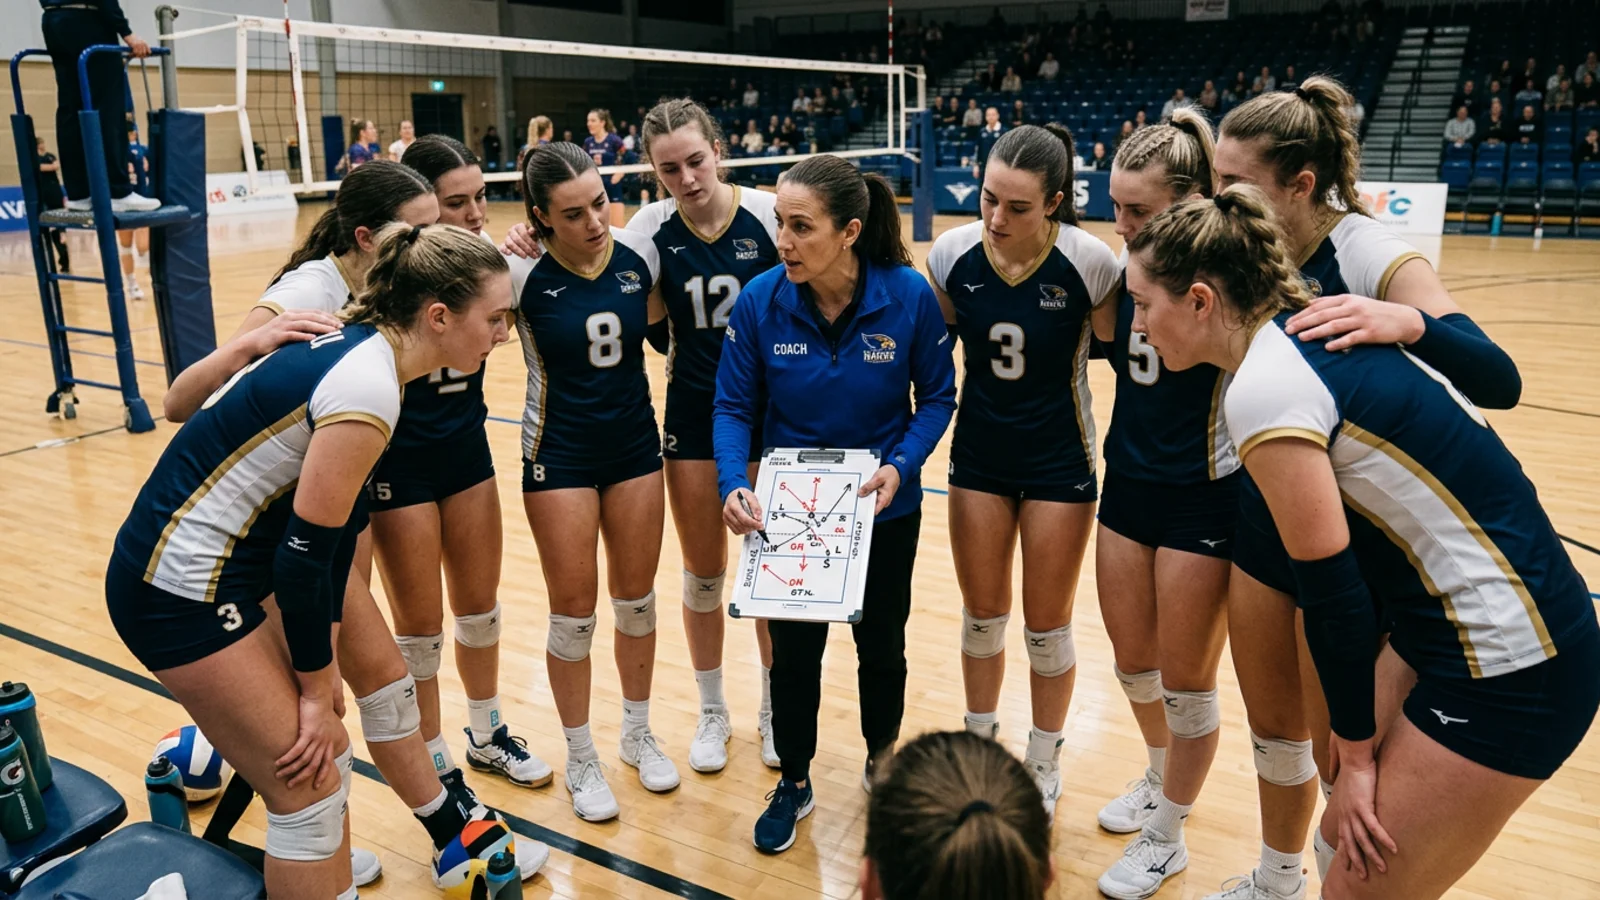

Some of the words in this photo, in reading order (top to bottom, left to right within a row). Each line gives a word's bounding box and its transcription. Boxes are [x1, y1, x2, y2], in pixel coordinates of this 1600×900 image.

[684, 274, 741, 329] 12
[586, 311, 622, 368] 8
[773, 343, 808, 355] COACH
[989, 322, 1025, 380] 3
[1128, 331, 1160, 386] 5
[533, 463, 546, 482] 8
[823, 558, 830, 568] S
[835, 545, 841, 553] L
[217, 602, 243, 631] 3
